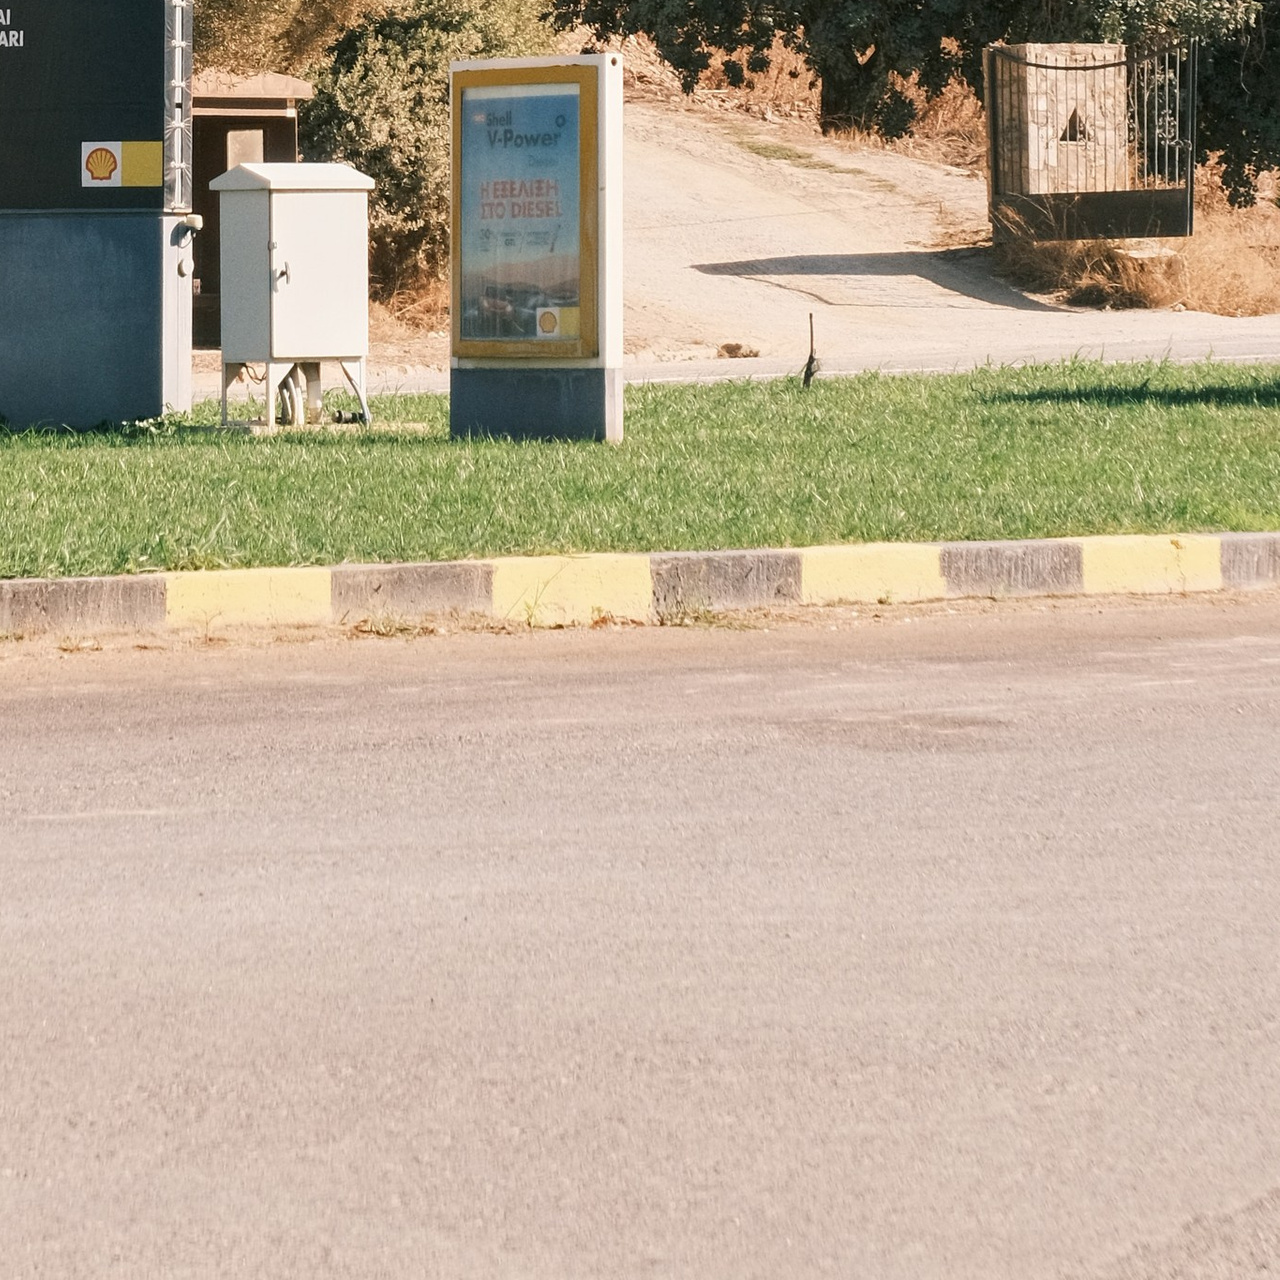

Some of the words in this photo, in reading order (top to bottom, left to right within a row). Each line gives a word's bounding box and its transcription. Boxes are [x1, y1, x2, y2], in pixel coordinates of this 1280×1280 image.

[486, 110, 512, 127] Shell
[486, 128, 562, 150] V-Power
[511, 200, 563, 219] DIESEL
